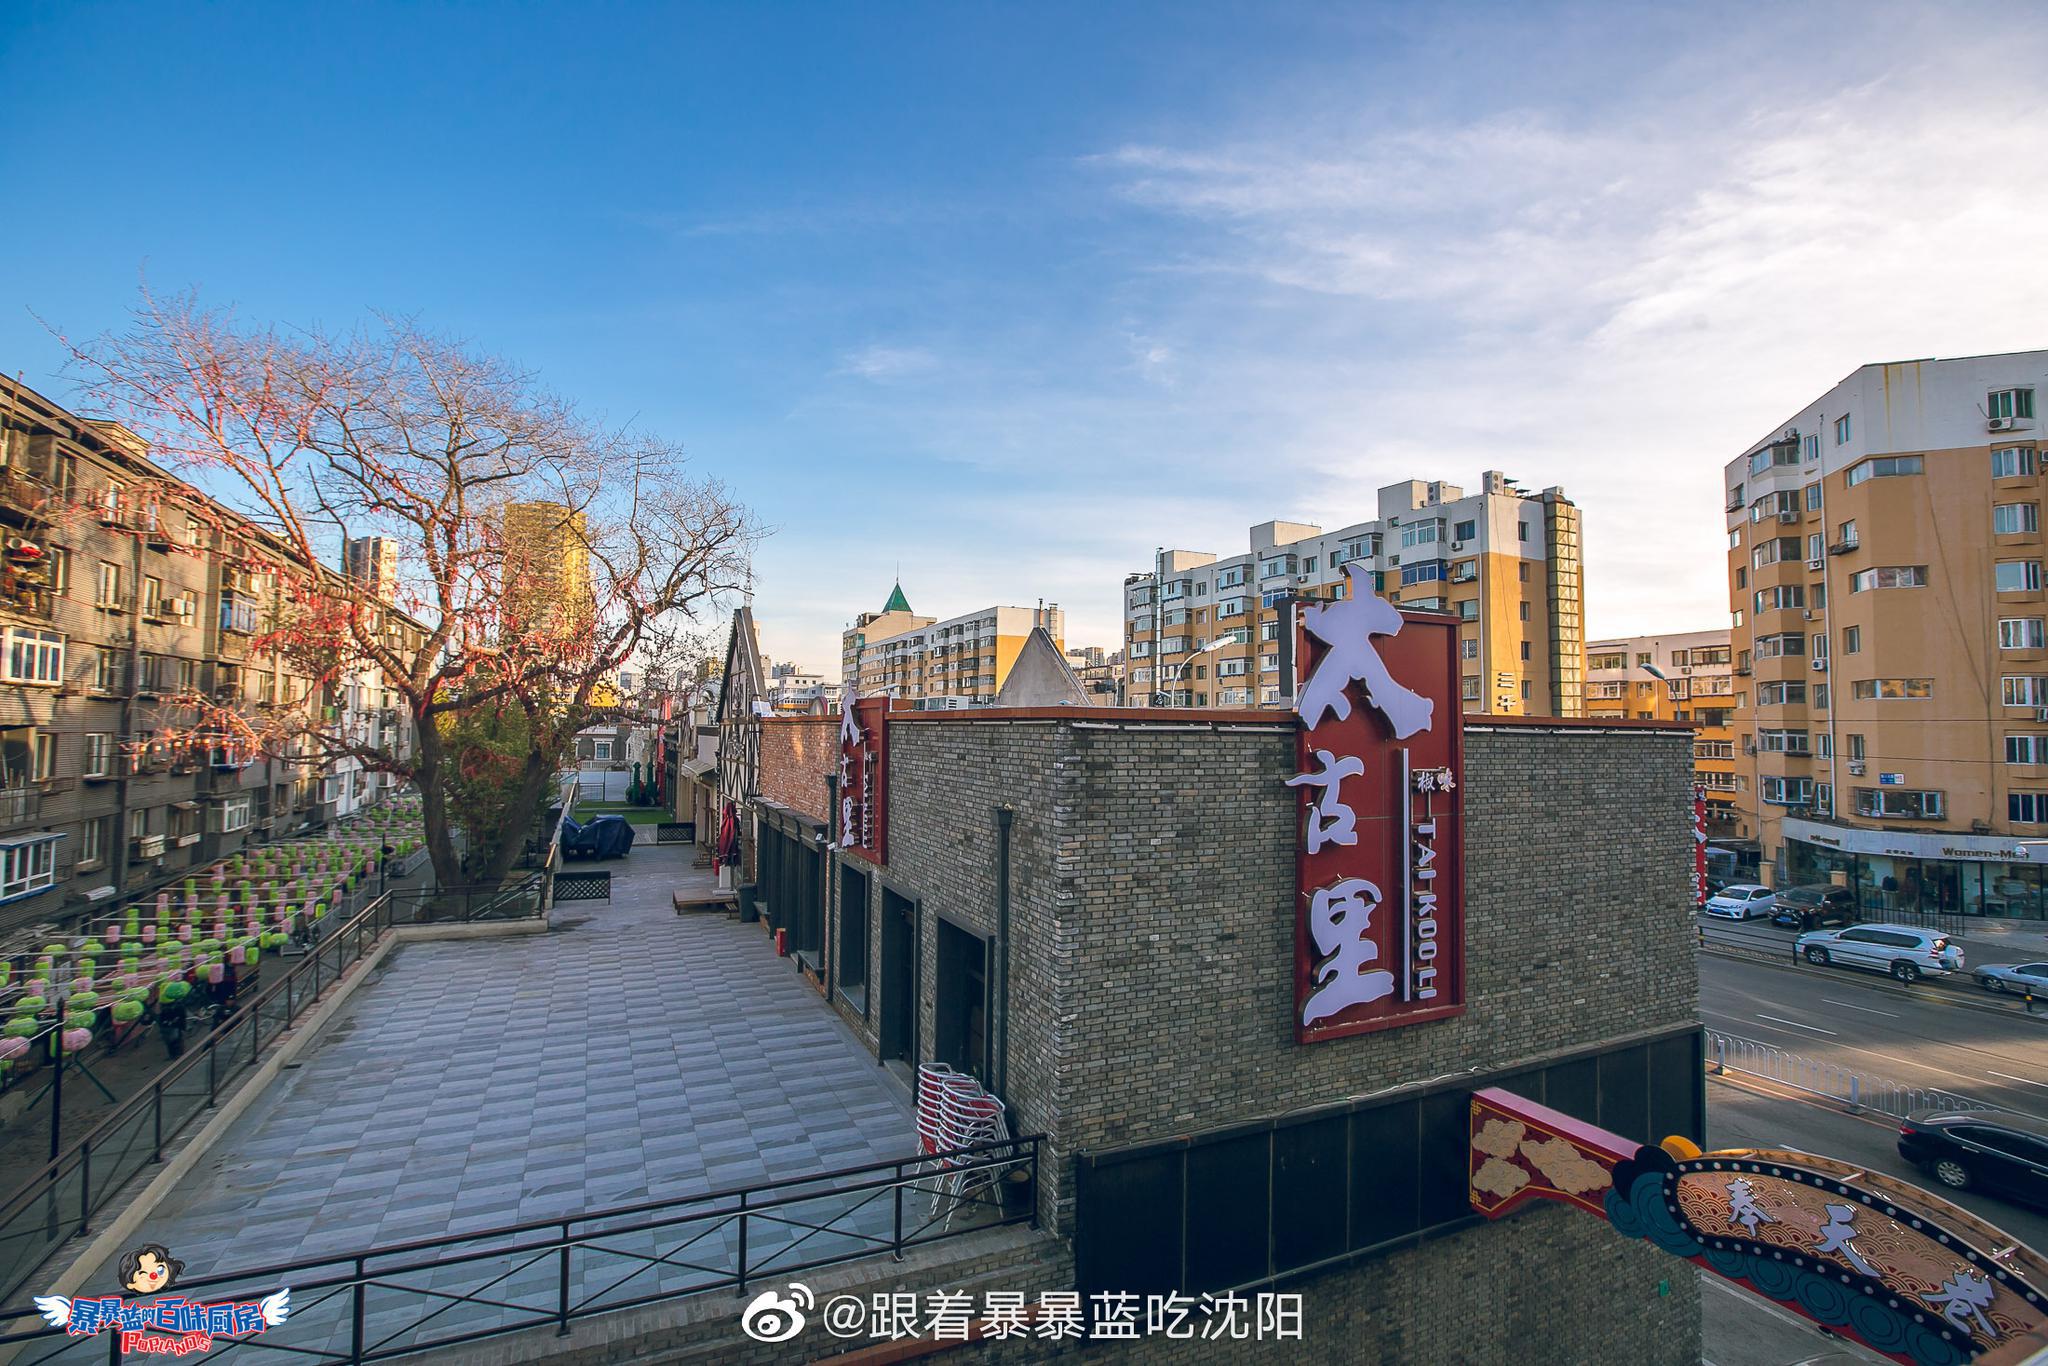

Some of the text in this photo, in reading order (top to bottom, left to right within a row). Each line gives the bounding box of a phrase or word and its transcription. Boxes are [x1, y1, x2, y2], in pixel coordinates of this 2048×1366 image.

[1284, 563, 1434, 1027] 太古里
[1418, 817, 1438, 880] TAI
[1418, 893, 1438, 960] KOO
